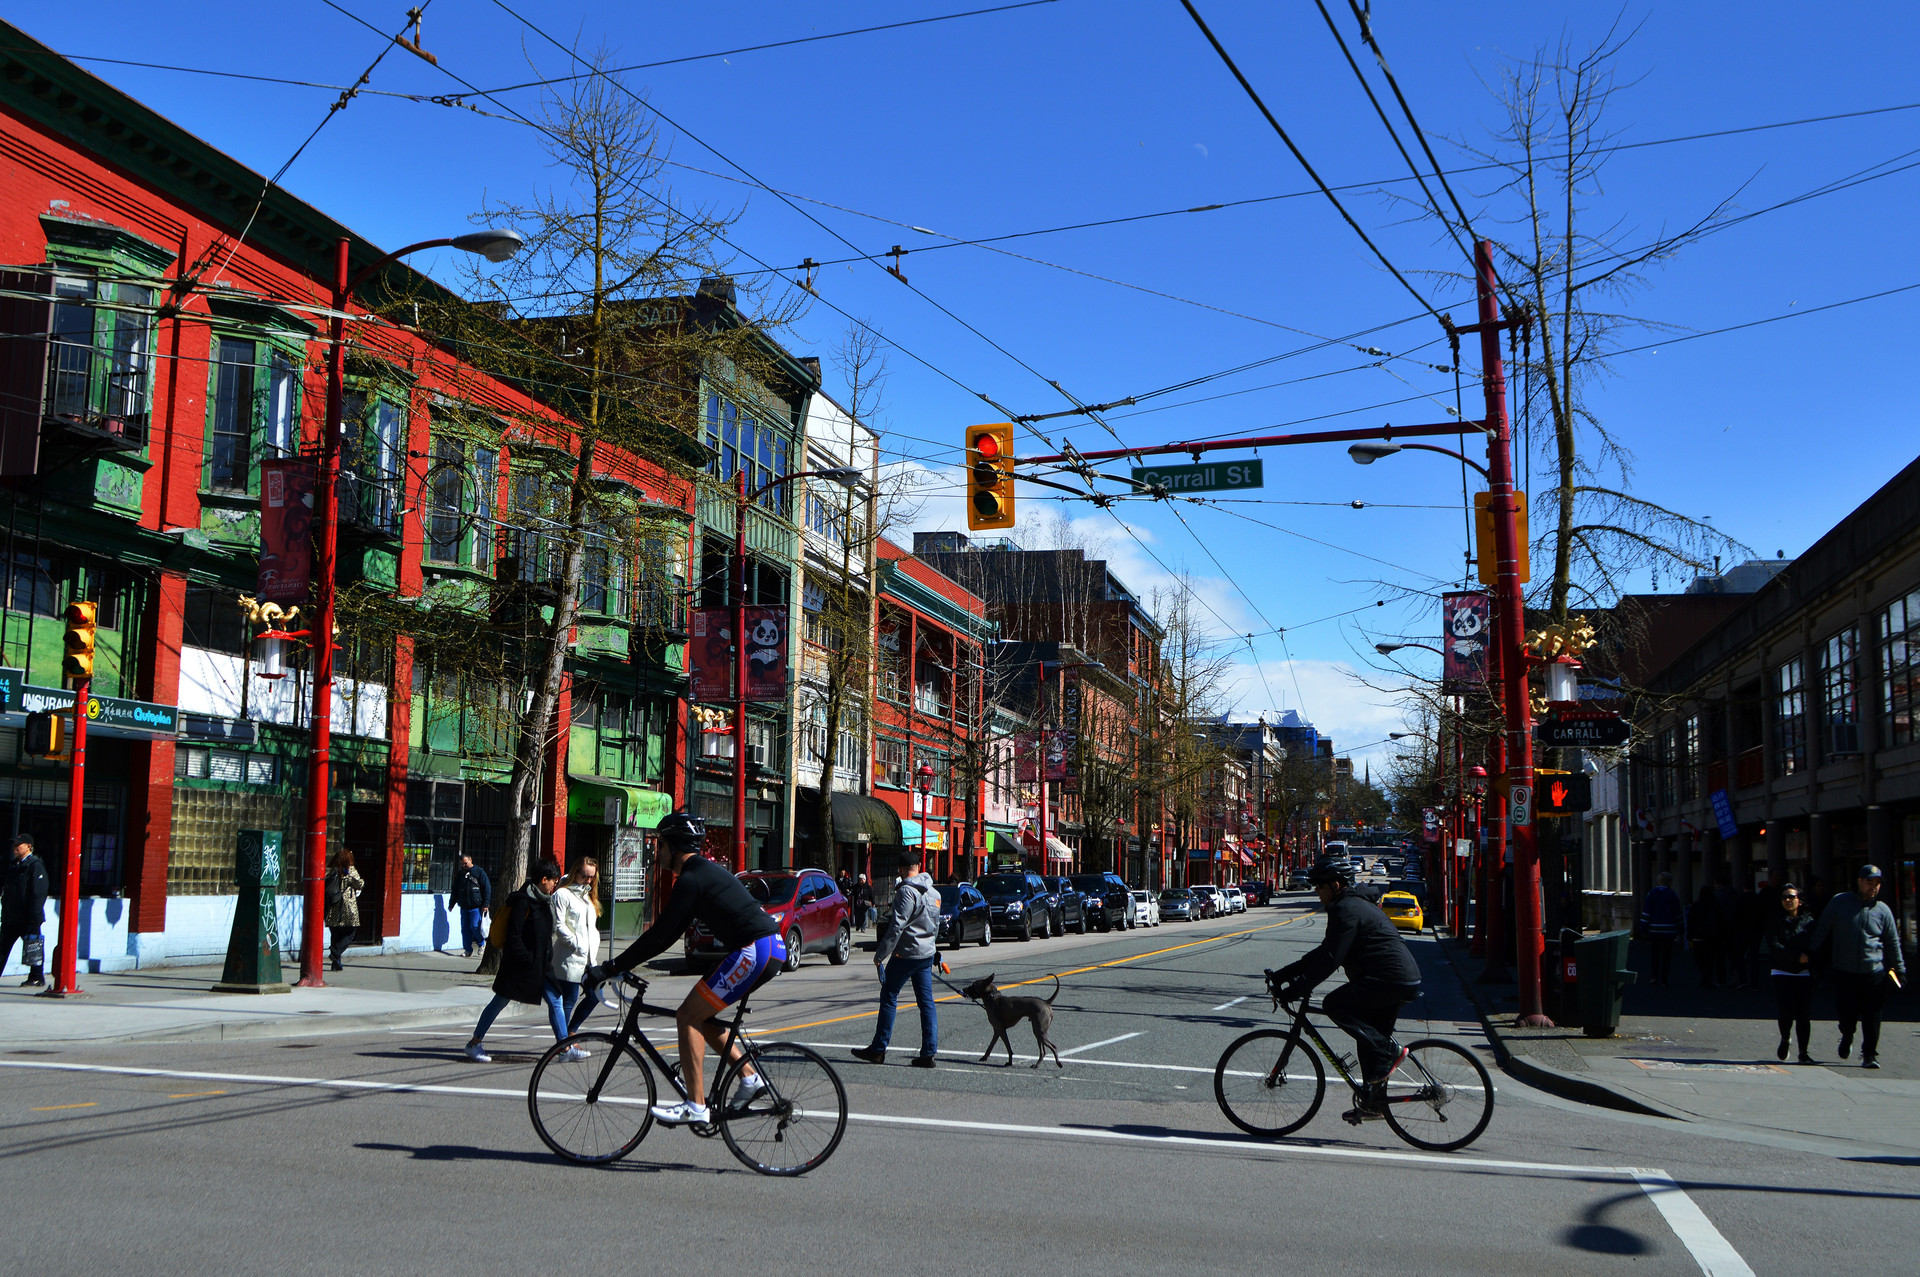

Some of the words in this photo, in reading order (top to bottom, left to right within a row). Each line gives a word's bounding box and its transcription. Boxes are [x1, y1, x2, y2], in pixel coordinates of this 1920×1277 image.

[1143, 467, 1216, 489] Carrall
[1226, 465, 1252, 485] St
[1553, 728, 1602, 739] CARRALL
[727, 956, 752, 985] TCR
